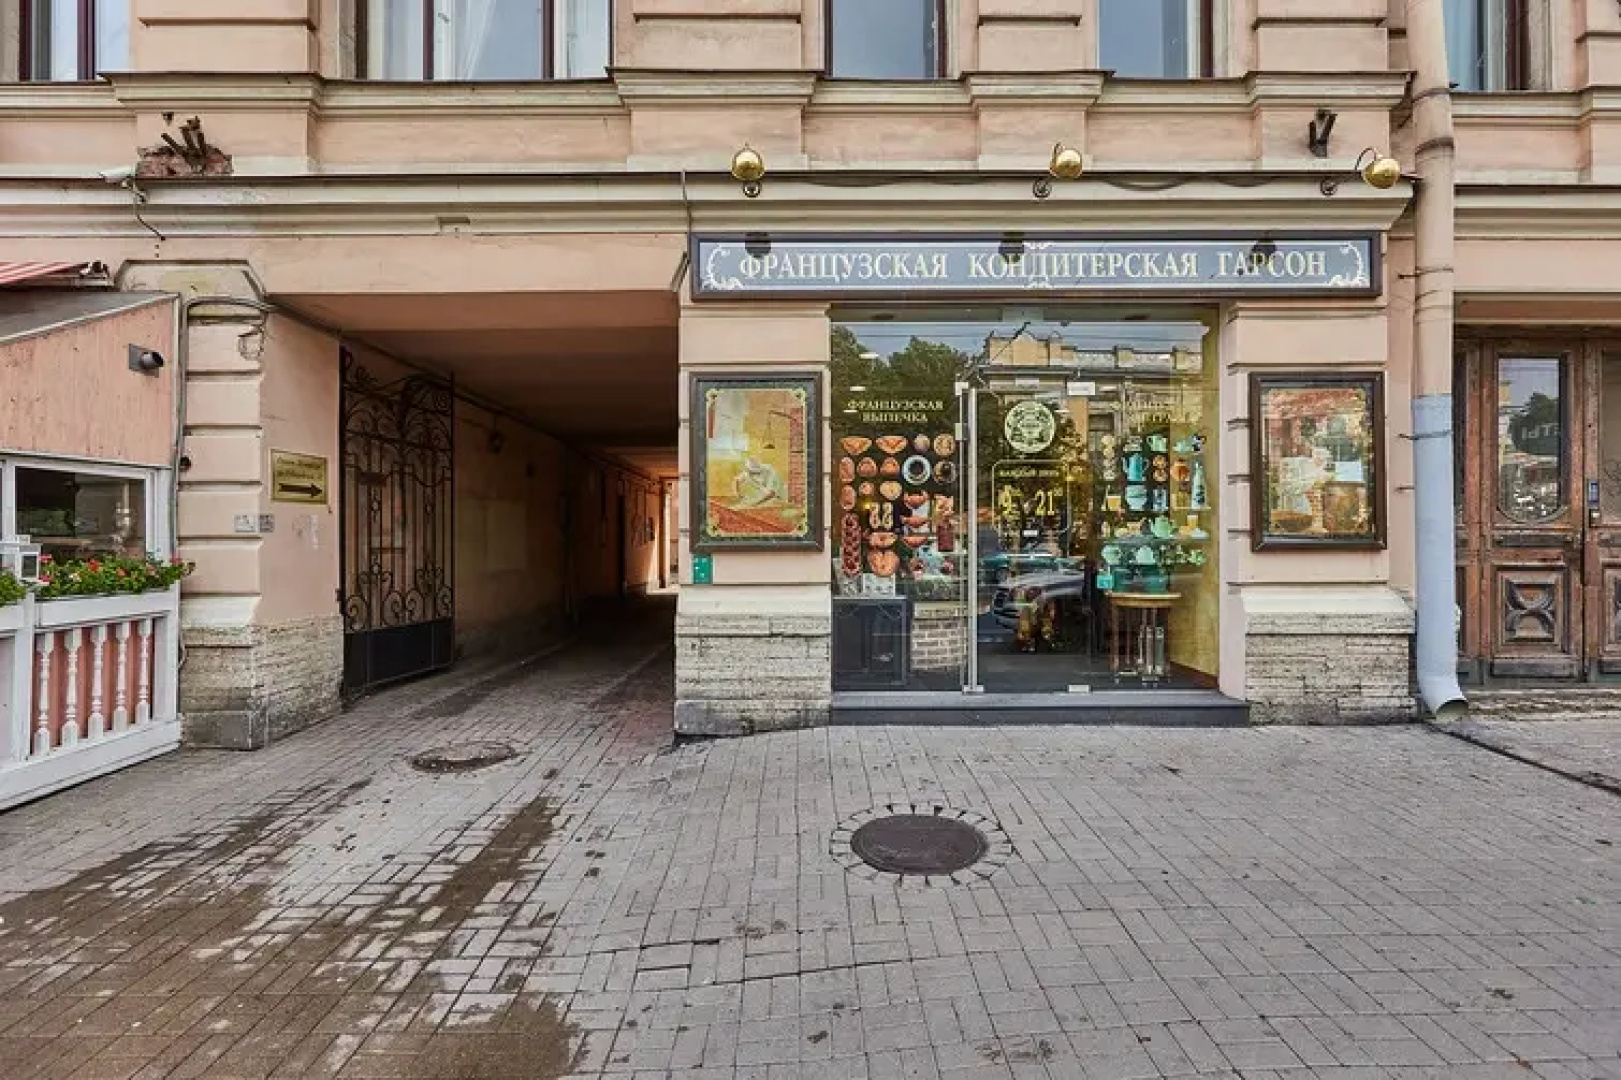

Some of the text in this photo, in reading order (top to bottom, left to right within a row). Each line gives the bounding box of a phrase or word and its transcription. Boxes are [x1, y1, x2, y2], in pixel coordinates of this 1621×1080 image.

[739, 251, 1327, 282] ФРАНЦУЗСКАЯ КОНДИТЕРСКАЯ ГАРСОН
